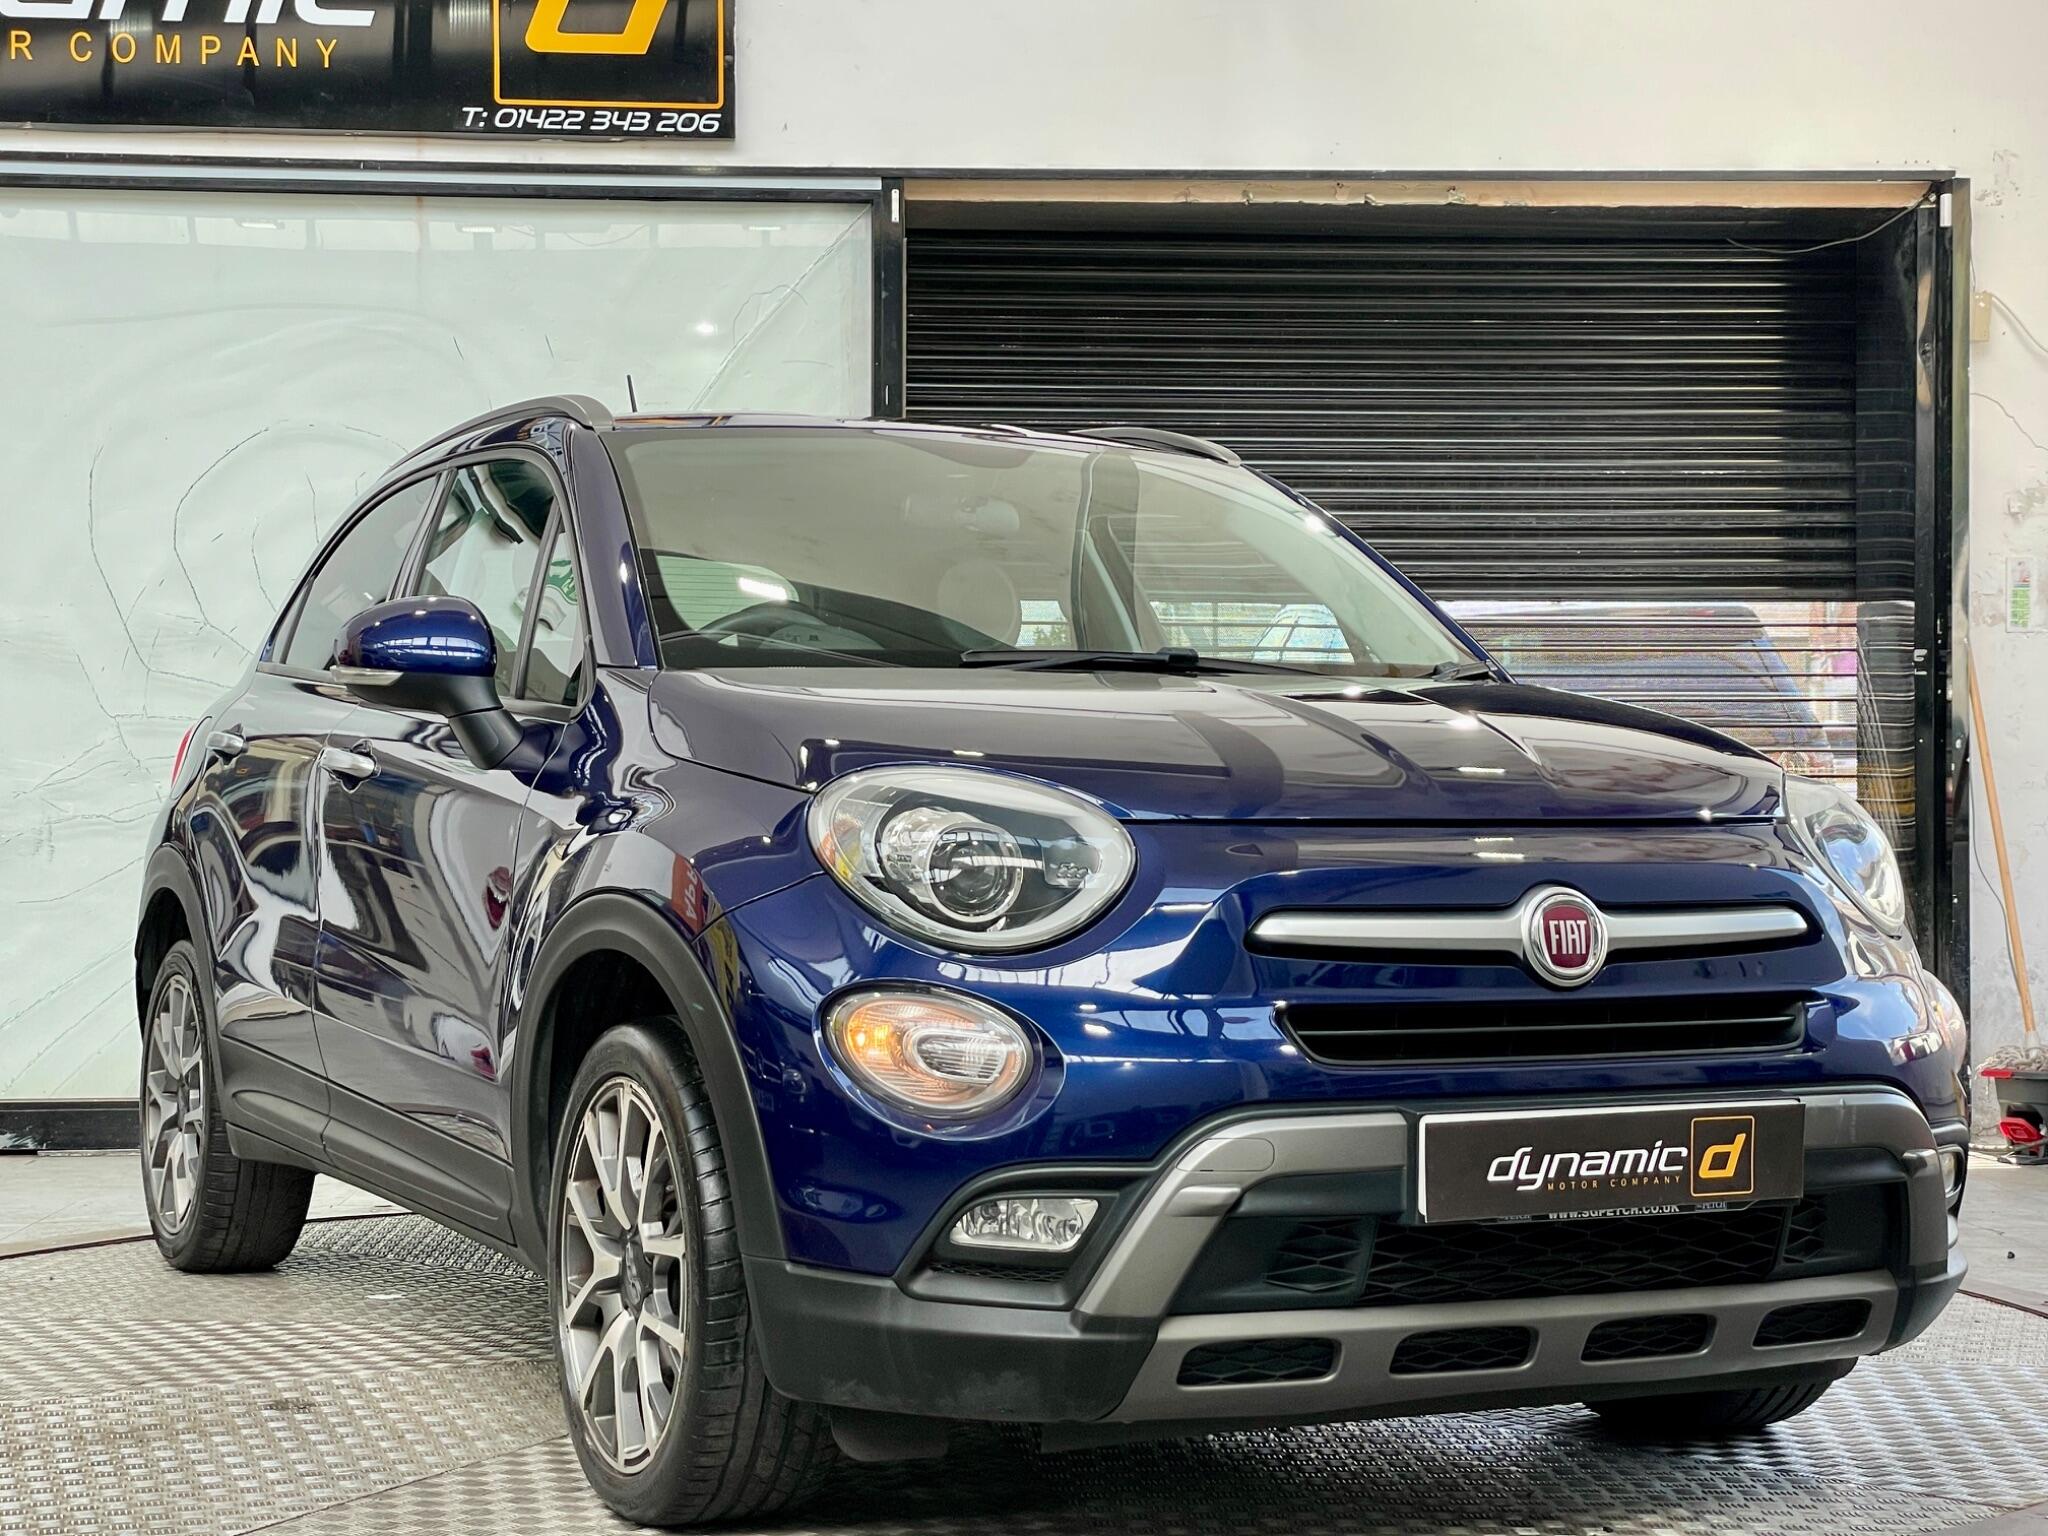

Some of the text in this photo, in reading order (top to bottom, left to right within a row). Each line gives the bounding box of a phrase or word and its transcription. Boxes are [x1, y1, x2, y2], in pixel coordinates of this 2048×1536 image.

[69, 31, 338, 68] COMPANY
[462, 107, 722, 133] T: 01422 343 206
[1548, 919, 1588, 955] FIAT
[1487, 1133, 1747, 1191] dynamic d
[1547, 1175, 1682, 1192] MOTOR COMPANY
